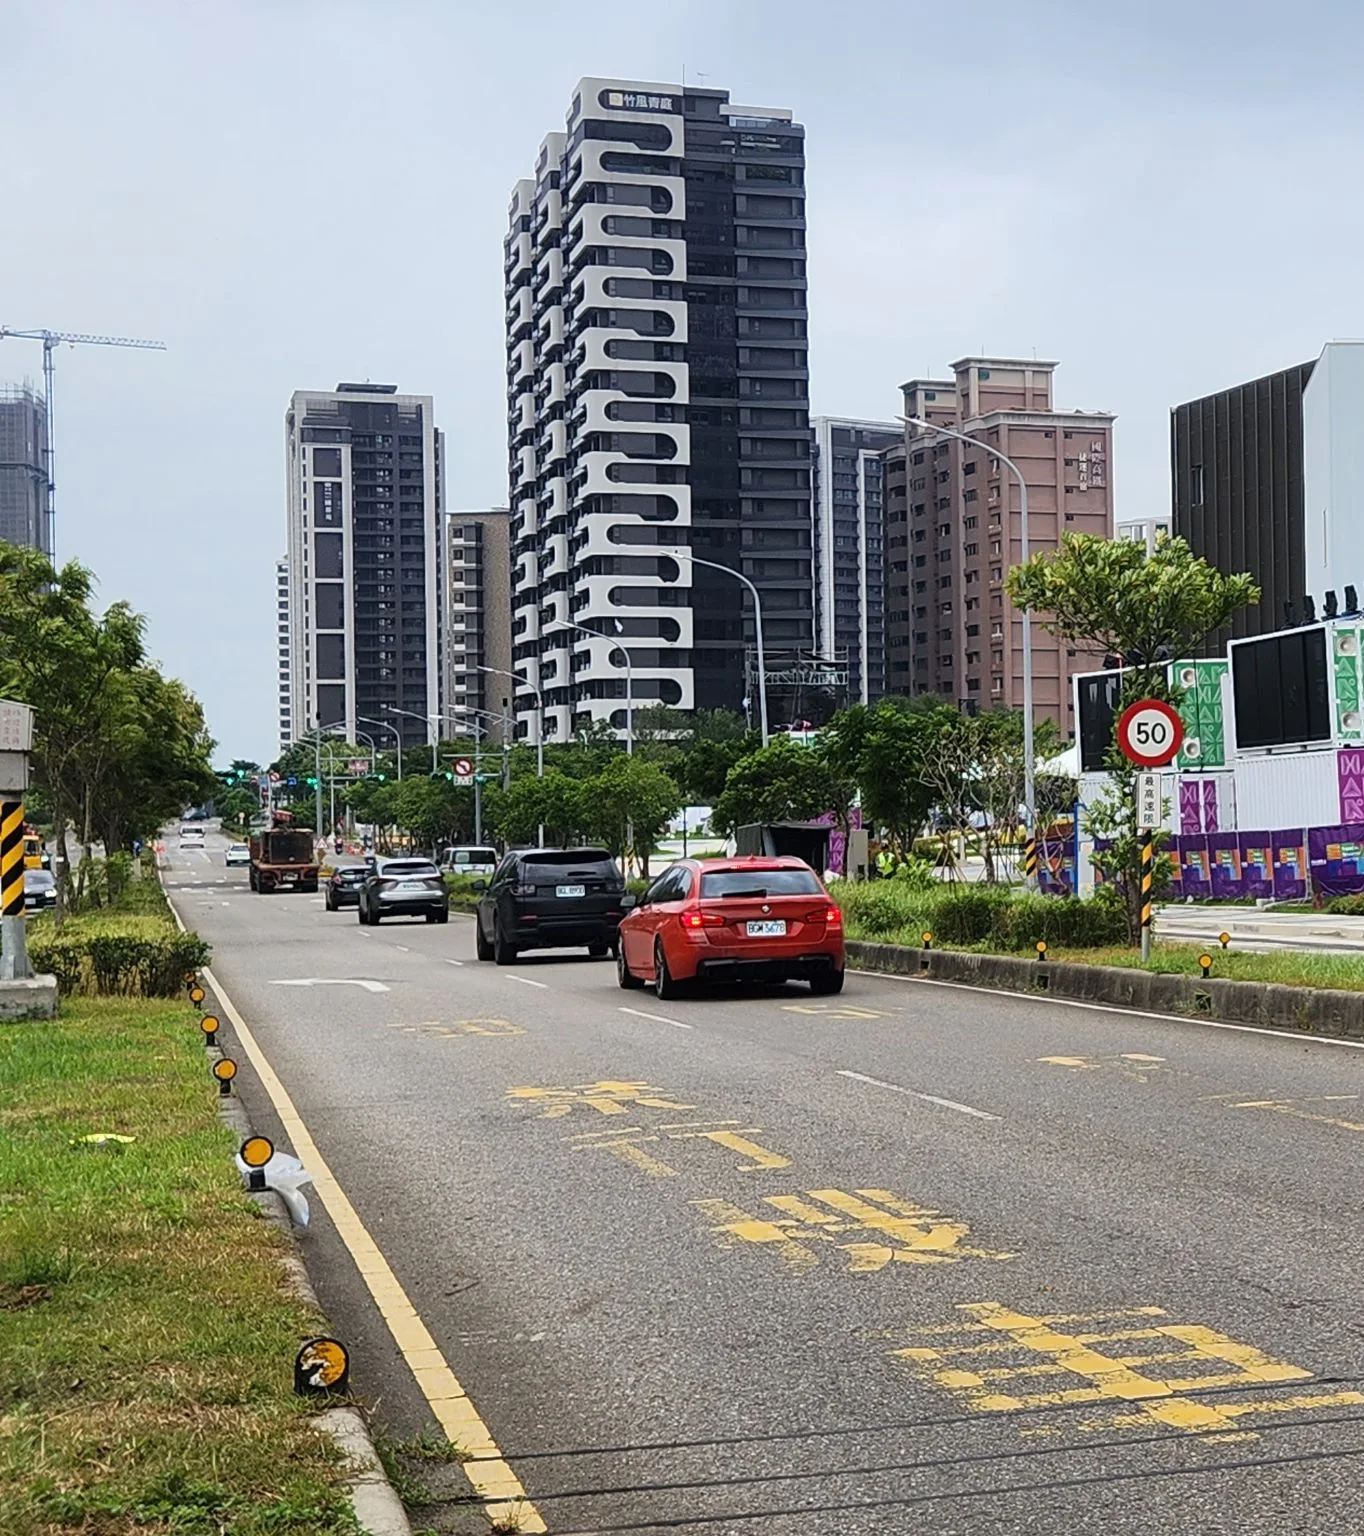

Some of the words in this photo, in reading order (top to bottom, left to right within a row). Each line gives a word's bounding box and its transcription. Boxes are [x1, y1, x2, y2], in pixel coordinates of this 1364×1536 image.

[1136, 721, 1166, 744] 50
[1143, 776, 1155, 824] 最高速限
